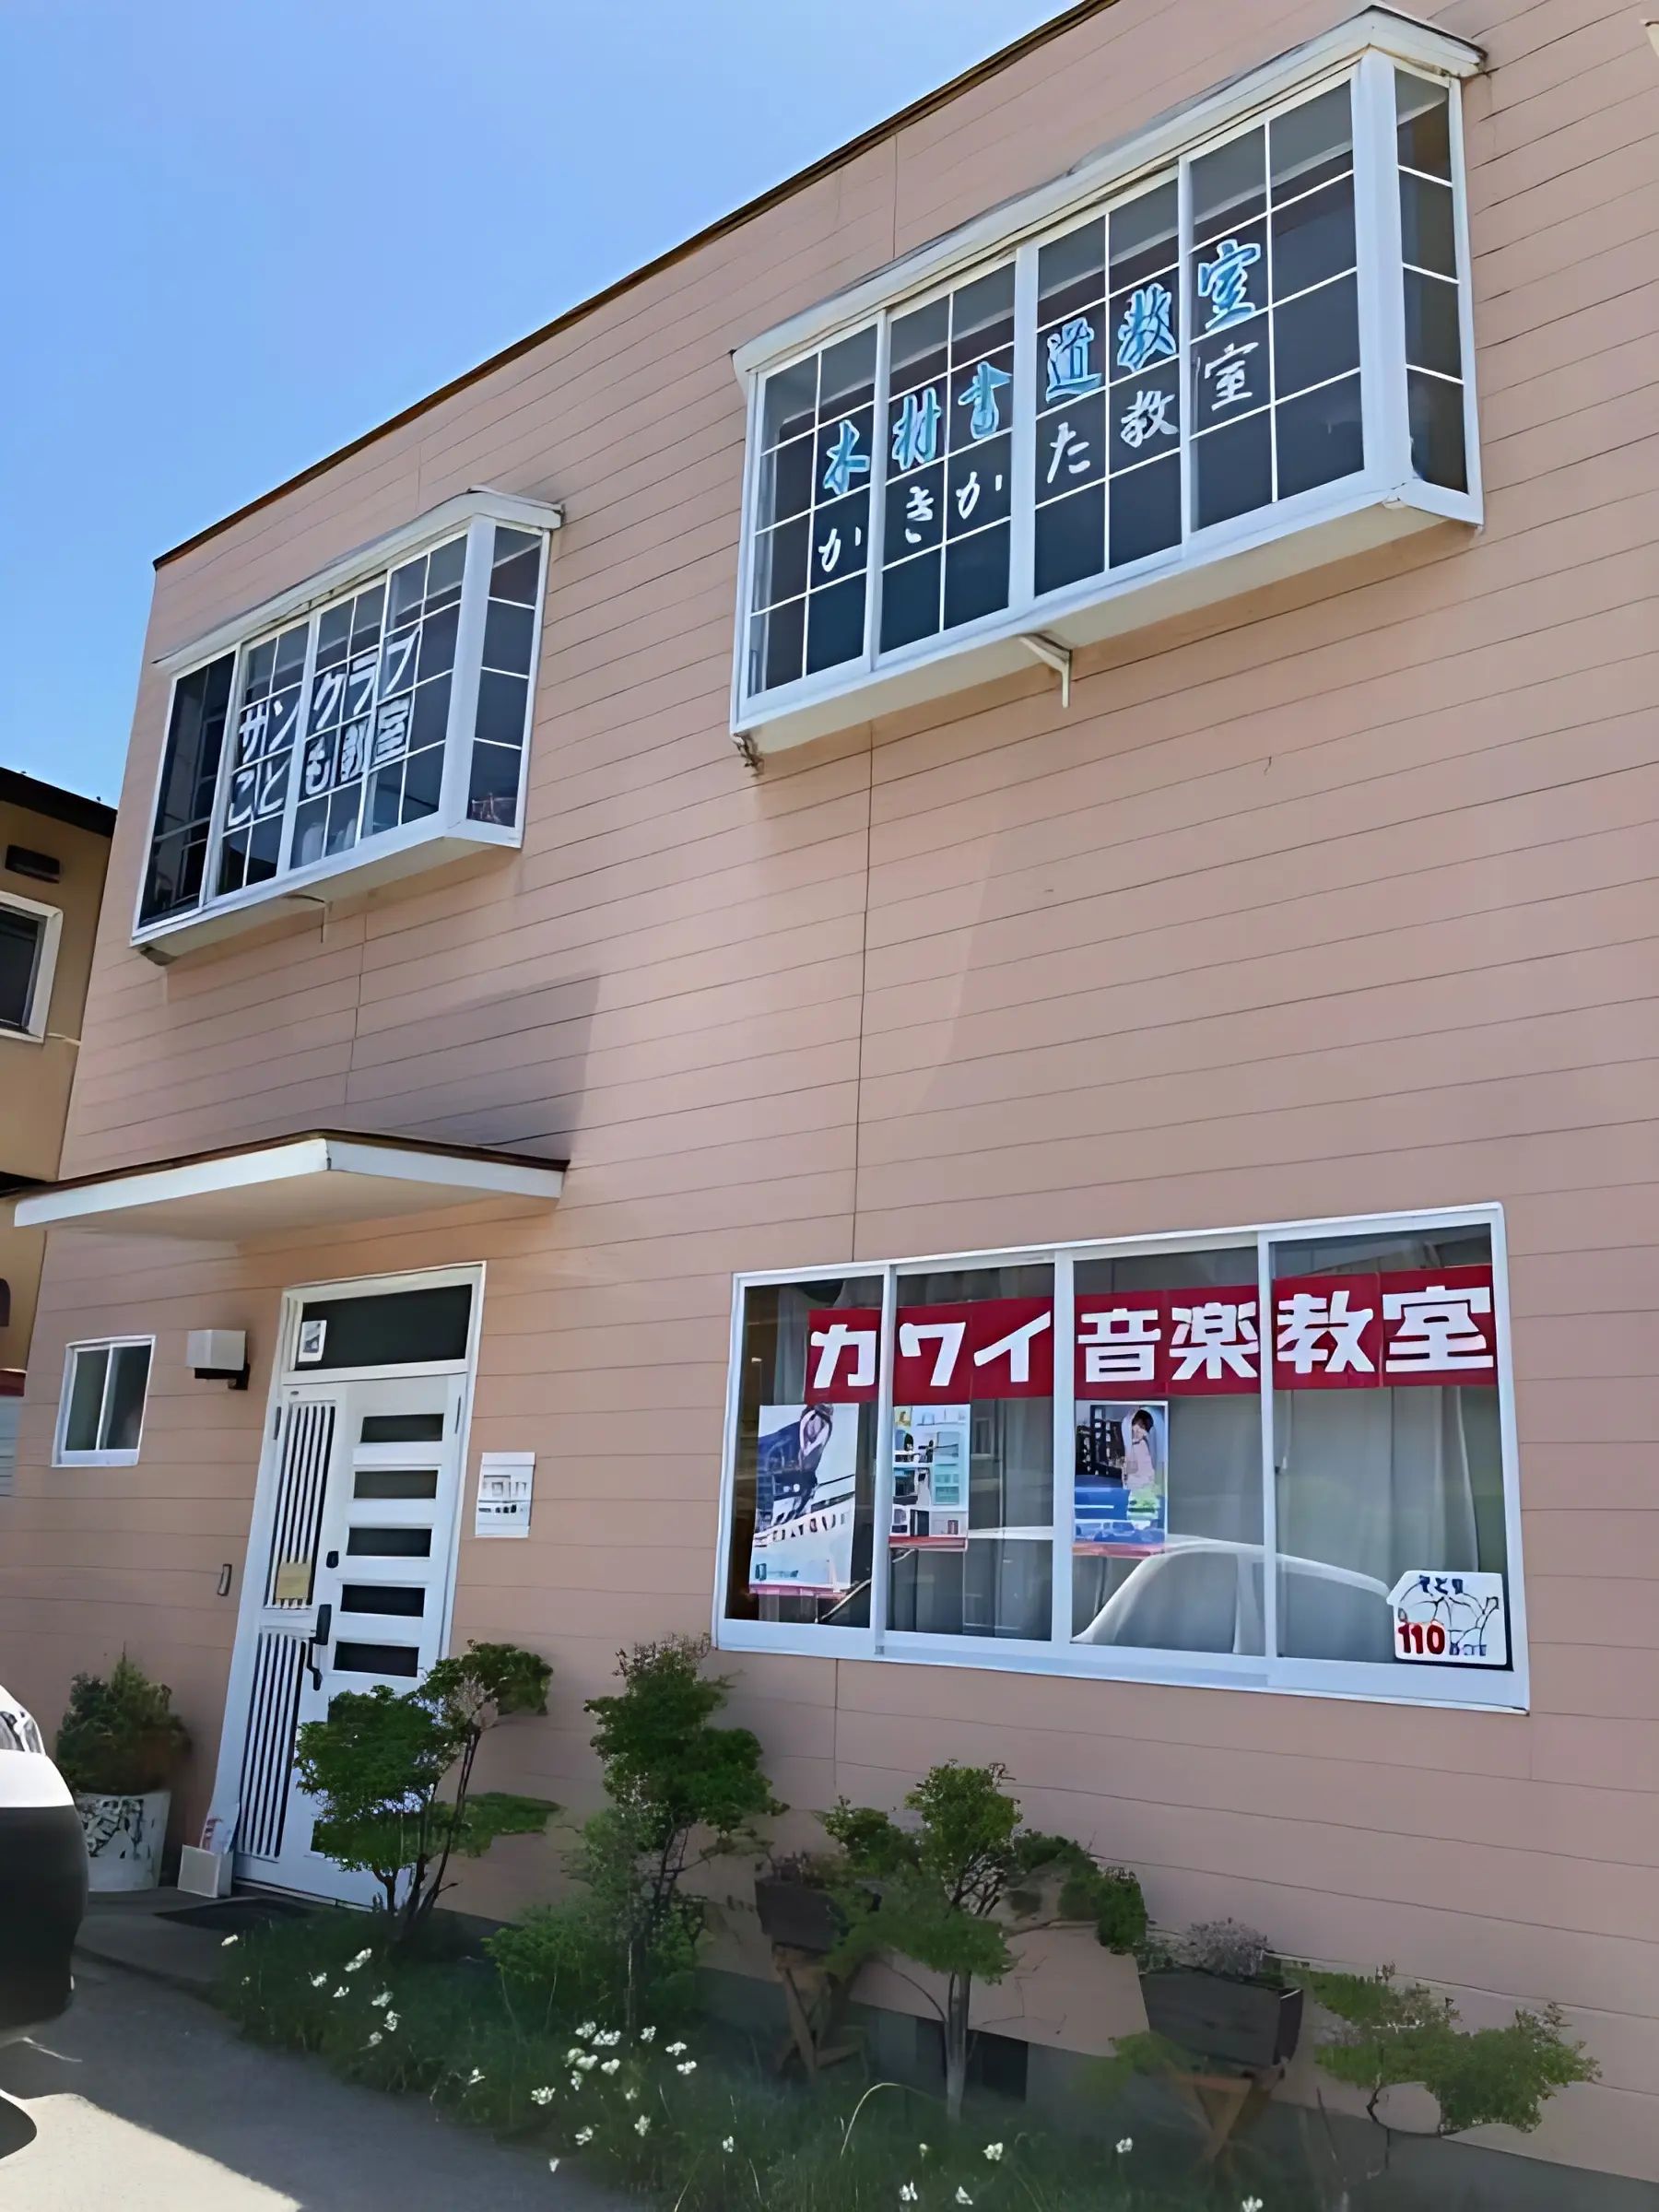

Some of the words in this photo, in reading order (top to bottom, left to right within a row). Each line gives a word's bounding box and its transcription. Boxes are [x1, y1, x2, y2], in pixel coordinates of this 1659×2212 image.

[818, 343, 1259, 572] かきかた教室
[811, 1286, 1494, 1389] カワイ音楽教室
